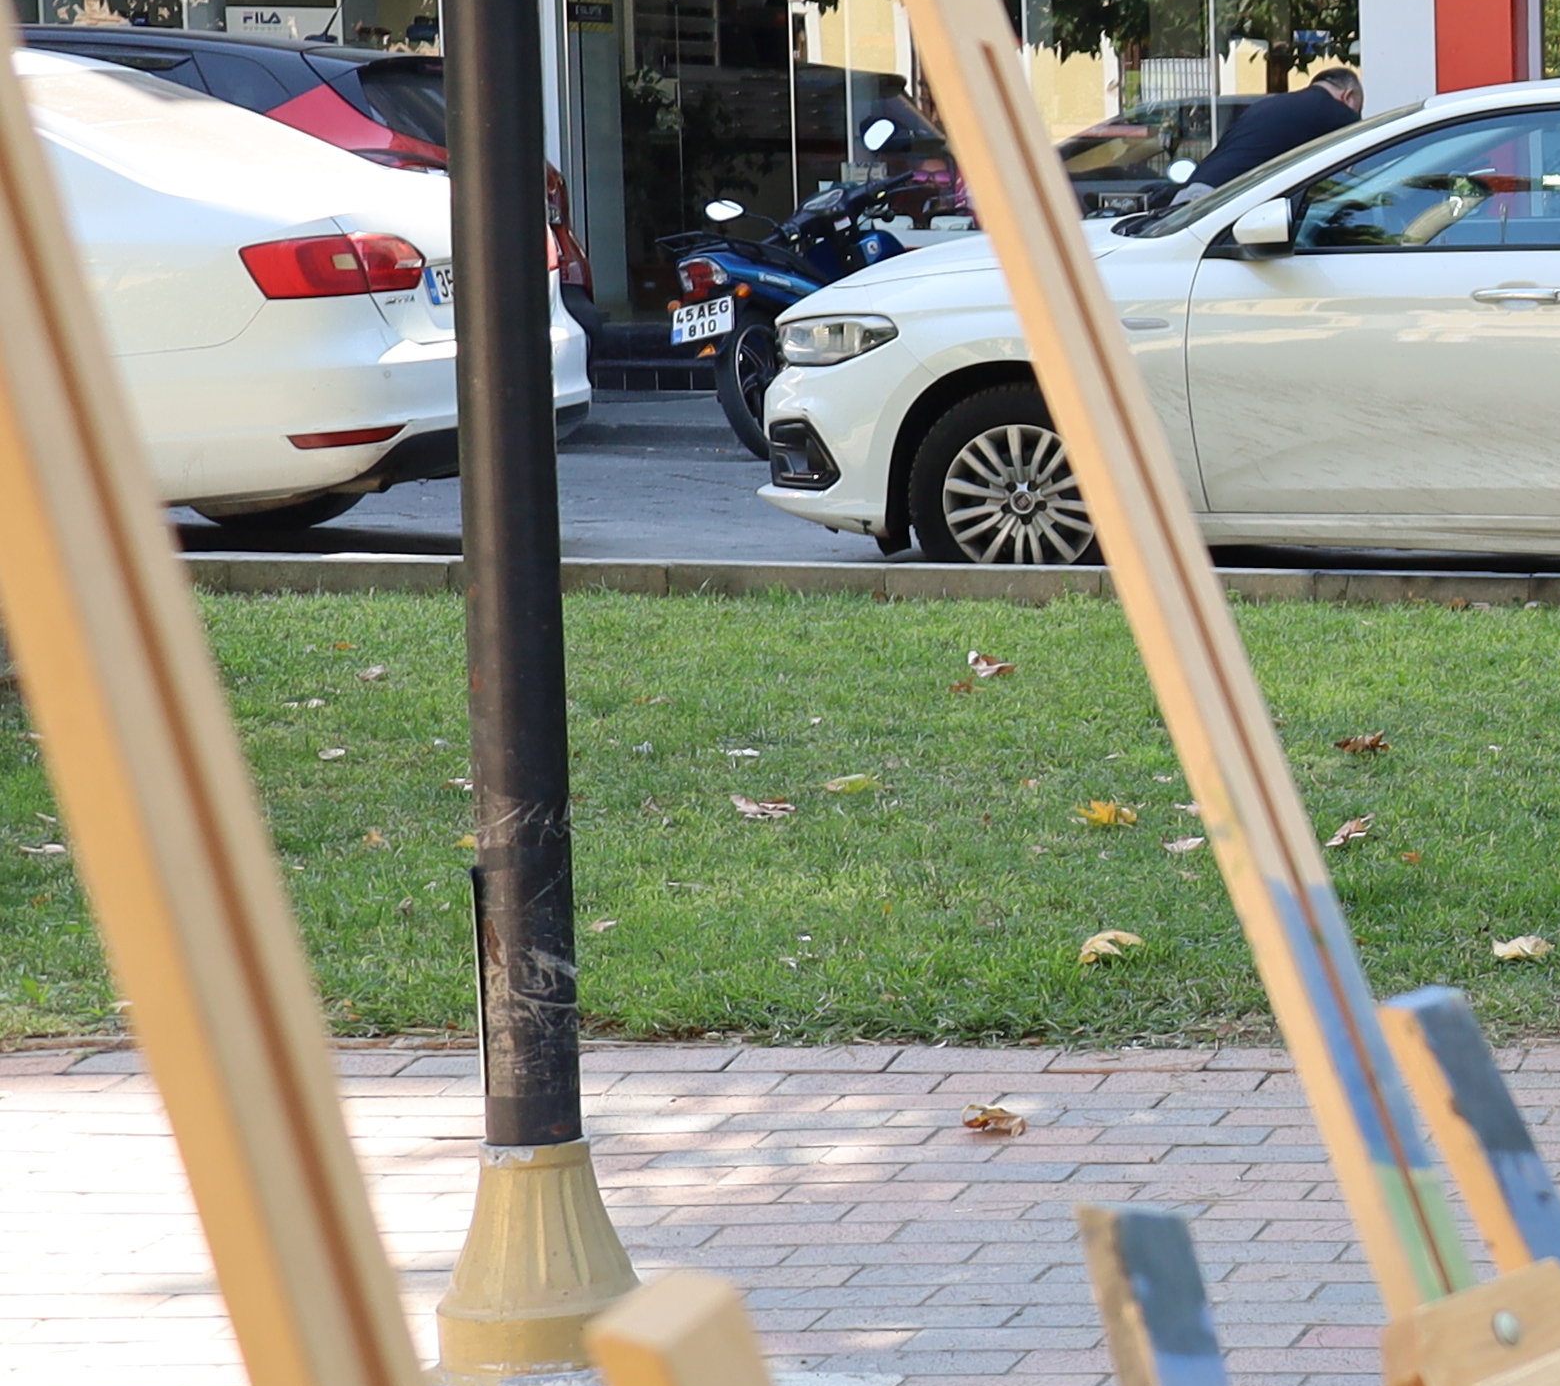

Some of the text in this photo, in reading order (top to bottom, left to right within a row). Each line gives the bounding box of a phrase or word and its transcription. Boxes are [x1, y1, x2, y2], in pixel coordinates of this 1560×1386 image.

[243, 11, 281, 24] FILA
[676, 299, 730, 324] 45 AEG
[688, 319, 717, 338] 810
